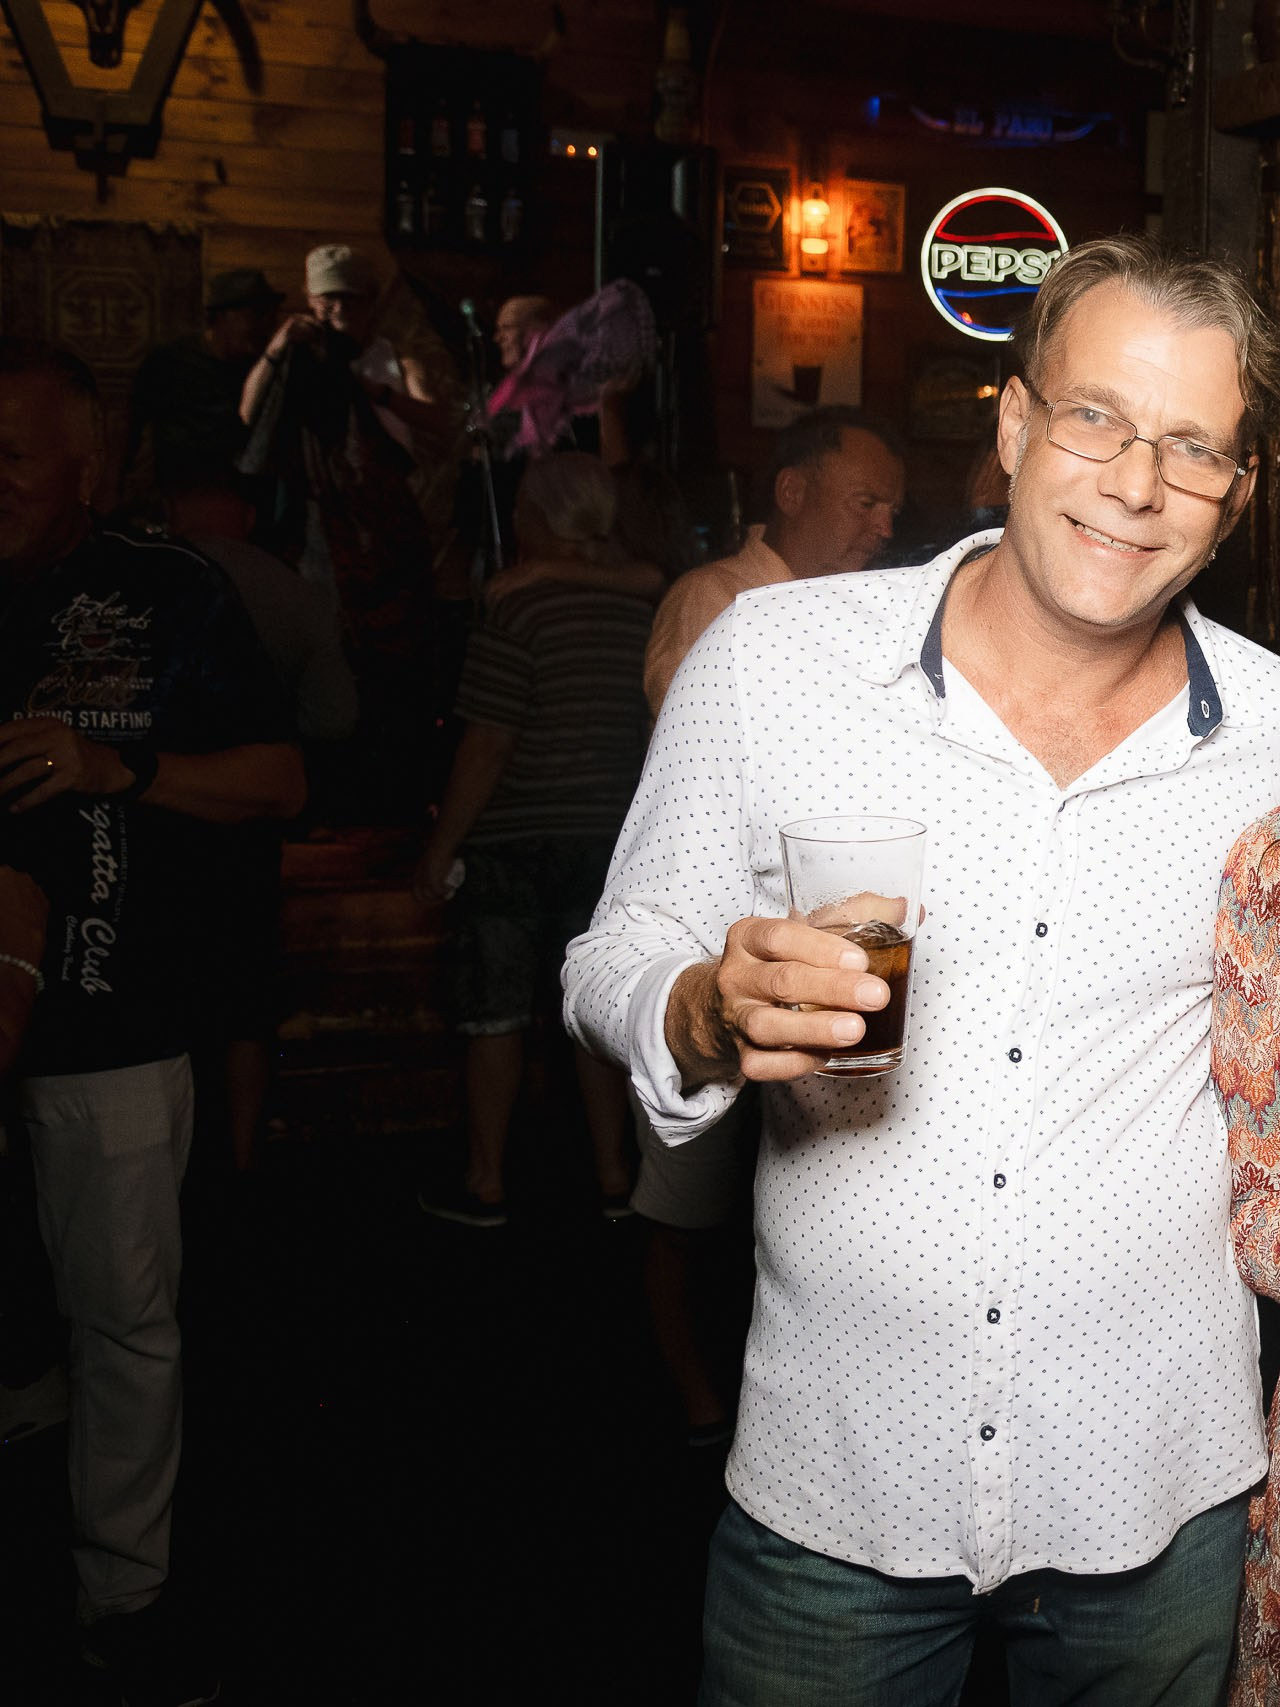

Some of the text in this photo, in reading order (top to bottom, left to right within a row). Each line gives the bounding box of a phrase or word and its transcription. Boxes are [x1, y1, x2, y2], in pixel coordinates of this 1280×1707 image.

[931, 243, 1062, 285] PEPS
[79, 711, 152, 728] STAFFING
[78, 802, 119, 996] gatta Club
